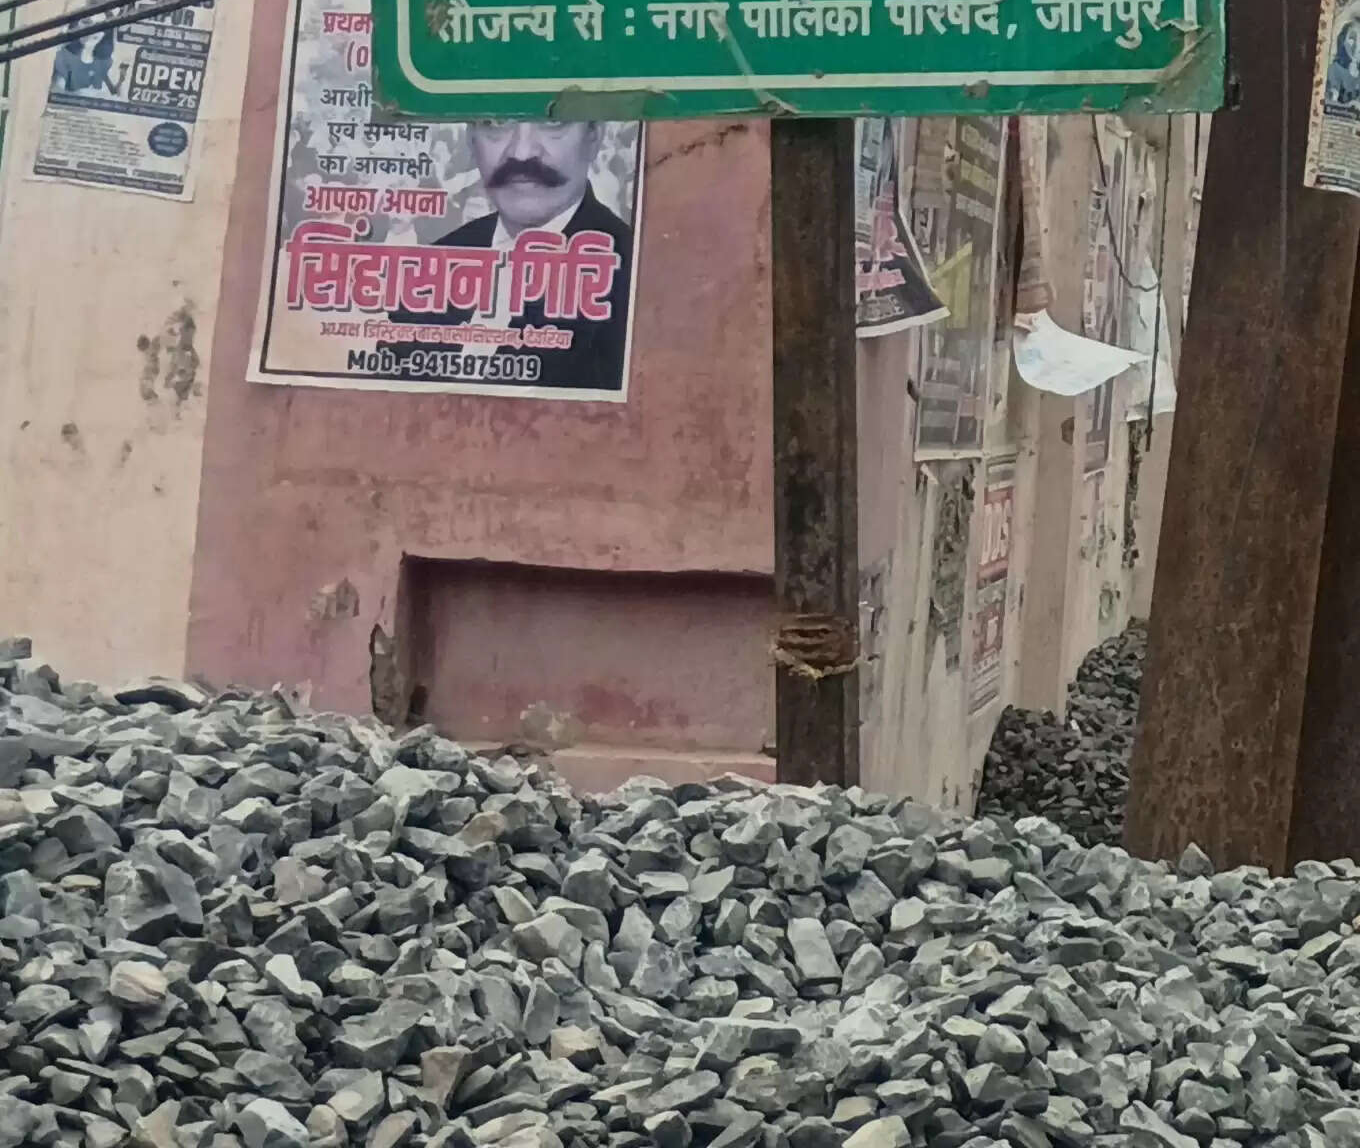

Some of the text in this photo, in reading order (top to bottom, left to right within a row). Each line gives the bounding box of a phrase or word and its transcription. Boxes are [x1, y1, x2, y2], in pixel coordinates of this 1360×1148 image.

[646, 1, 730, 43] नगर
[135, 62, 202, 93] OPEN
[131, 86, 198, 109] 2025-26
[327, 119, 358, 143] एवं
[318, 152, 433, 179] का आकांक्षी
[304, 185, 449, 216] आपका अपना
[286, 217, 619, 320] सिंहासन गिरि
